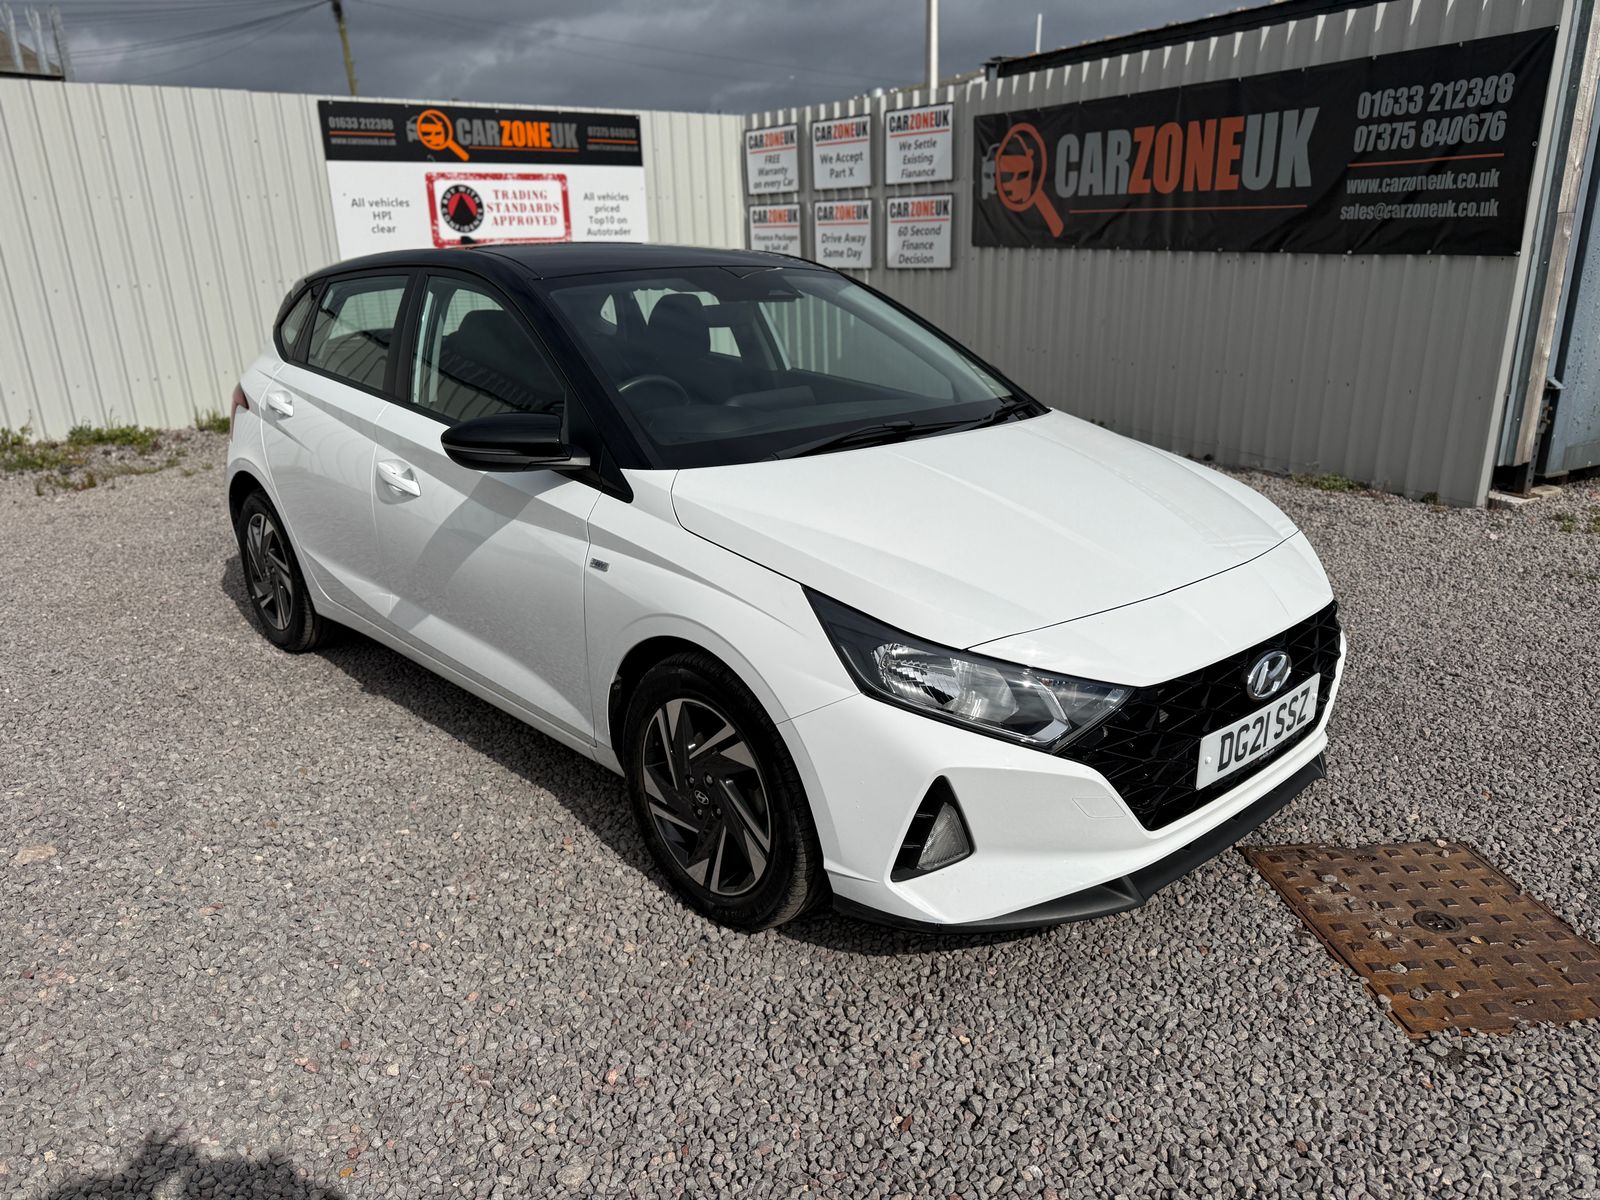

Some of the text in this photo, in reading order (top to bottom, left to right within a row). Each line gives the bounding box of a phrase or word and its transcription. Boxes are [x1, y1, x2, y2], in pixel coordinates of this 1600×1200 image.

[1357, 72, 1516, 120] 01633 212398
[328, 116, 359, 129] 01633
[889, 109, 950, 132] CARZONEUK
[456, 117, 579, 149] CARZONEUK
[814, 121, 868, 142] CARZONEUK
[1353, 110, 1508, 152] 07375 840676
[748, 130, 796, 150] CARZONEUK
[899, 138, 937, 151] We Settle
[820, 152, 864, 164] We Accept
[1054, 107, 1320, 198] CARZONEUK
[764, 154, 781, 165] FREE
[902, 153, 934, 165] Existing
[757, 166, 789, 177] Warranty
[829, 167, 855, 178] Part X
[753, 177, 794, 190] on every Car
[1346, 168, 1500, 194] www.carzoneuk.co.uk
[493, 190, 548, 200] TRADING
[583, 192, 629, 201] All vehicles
[351, 198, 410, 208] All vehicles
[486, 203, 560, 213] STANDARDS
[594, 204, 620, 214] priced
[889, 199, 950, 218] CARZONEUK
[373, 211, 392, 220] HPI
[817, 204, 869, 221] CARZONEUK
[1340, 198, 1499, 221] sales@carzoneuk.co.uk
[492, 216, 557, 226] APPROVED
[589, 216, 615, 226] Top10
[371, 225, 396, 234] clear
[587, 228, 631, 236] Autotrader
[898, 224, 941, 237] 60 Second
[821, 233, 866, 245] Drive Away
[902, 240, 935, 250] Finance
[823, 247, 862, 260] Same Day
[898, 253, 934, 264] Decision
[1217, 687, 1310, 772] DG21 SSZ
